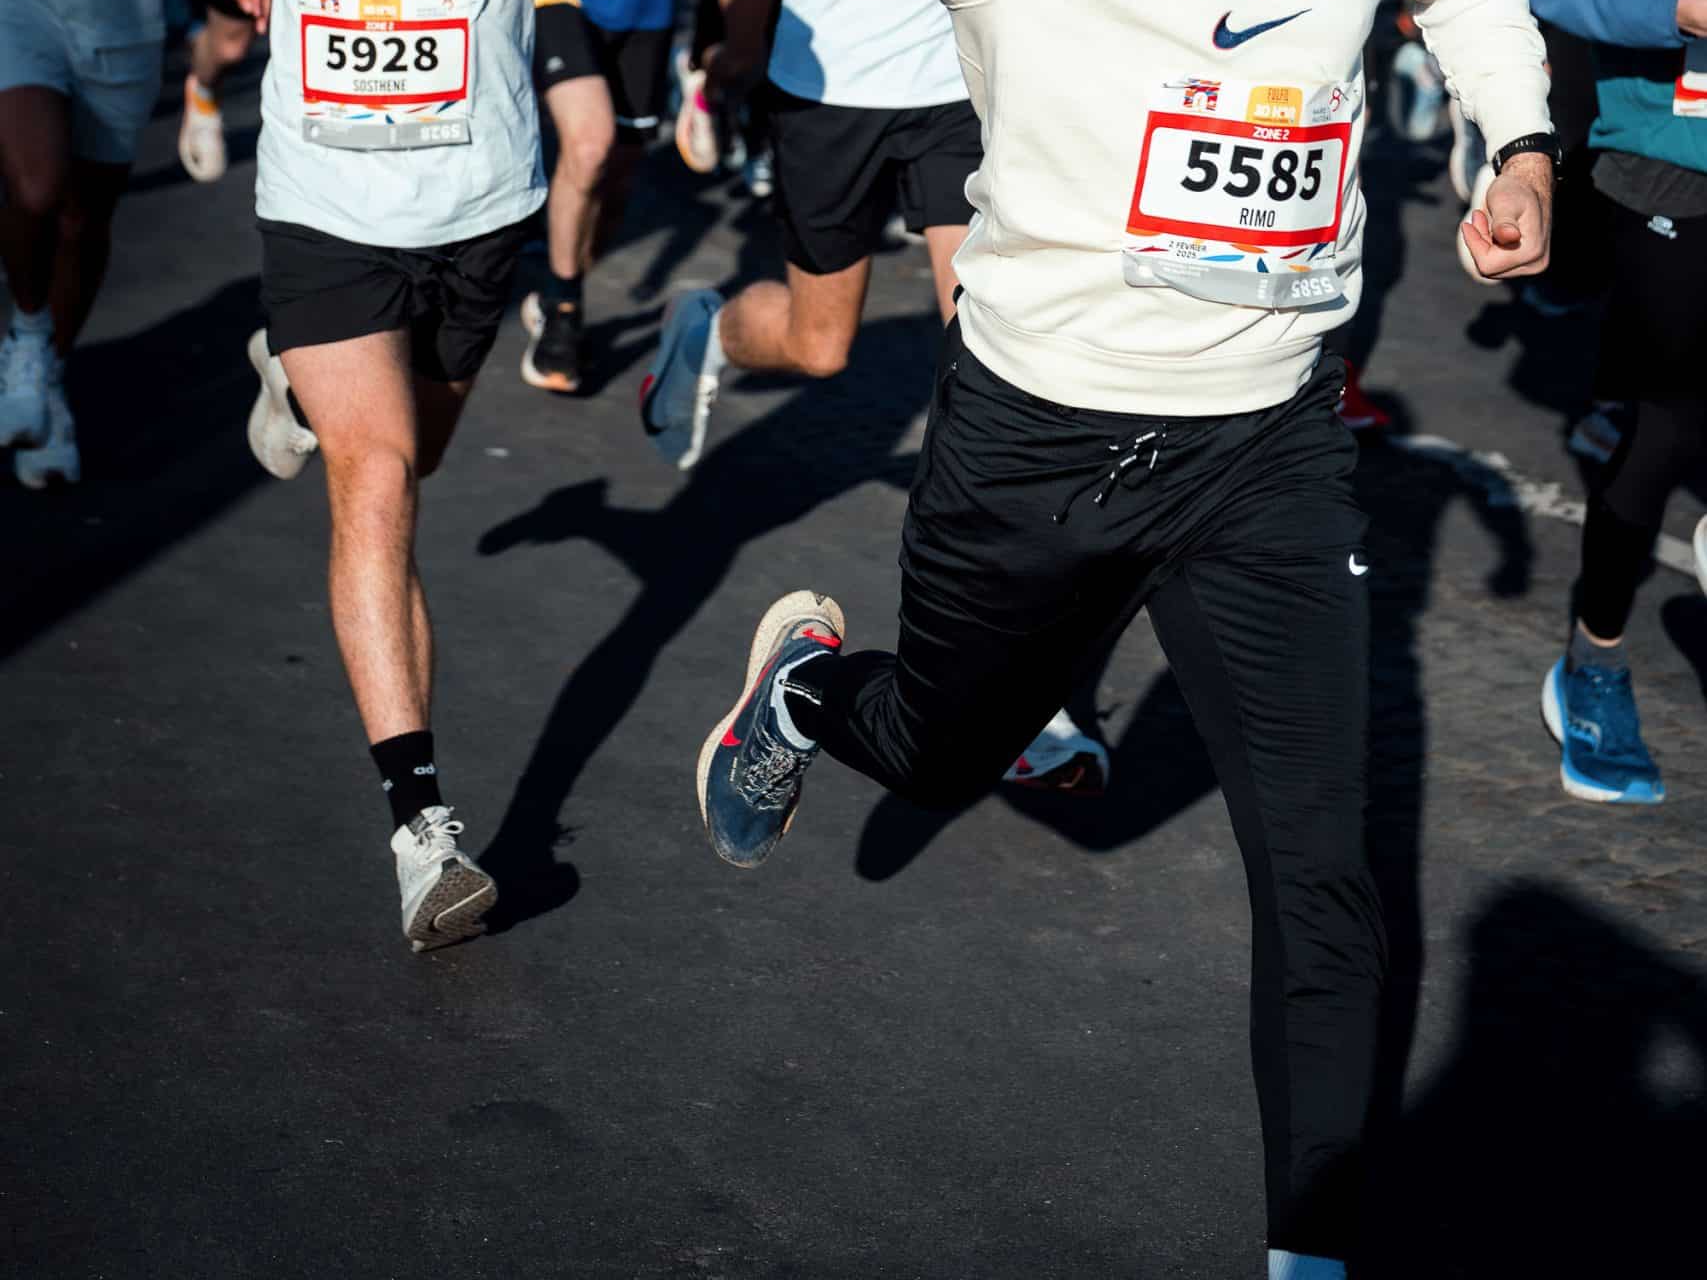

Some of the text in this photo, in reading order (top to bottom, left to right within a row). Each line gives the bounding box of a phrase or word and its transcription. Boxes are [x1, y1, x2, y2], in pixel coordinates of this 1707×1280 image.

[326, 34, 439, 73] 5928
[353, 79, 408, 93] SOSTHENE
[1252, 126, 1290, 140] ZONE 2
[1181, 139, 1324, 201] 5585
[1239, 207, 1276, 228] RIMO
[1291, 276, 1337, 299] 5585
